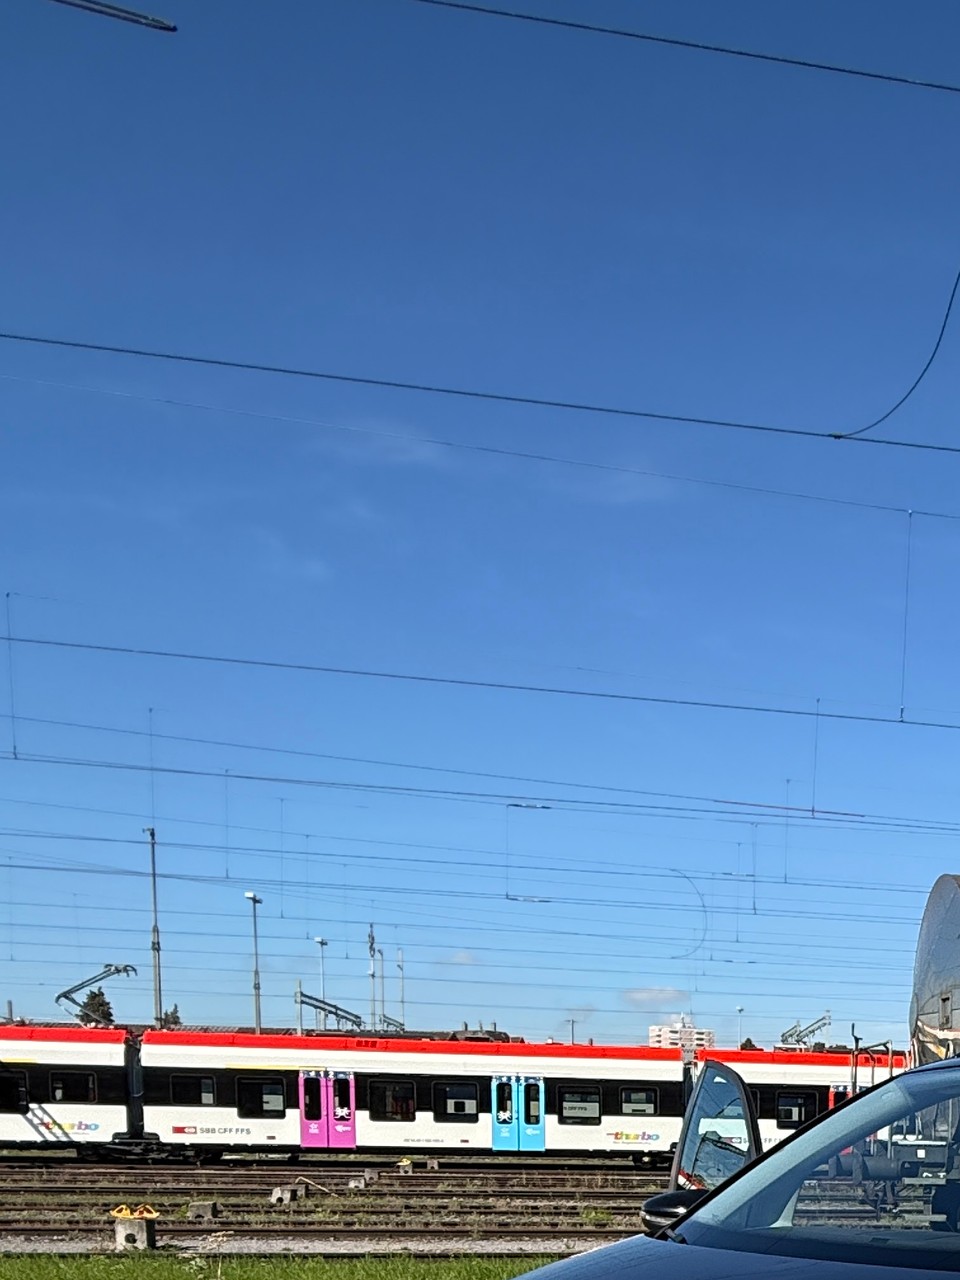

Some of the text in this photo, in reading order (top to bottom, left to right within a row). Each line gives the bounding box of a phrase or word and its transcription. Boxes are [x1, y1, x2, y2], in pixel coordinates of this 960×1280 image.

[199, 1127, 252, 1136] SBB CFF FFS
